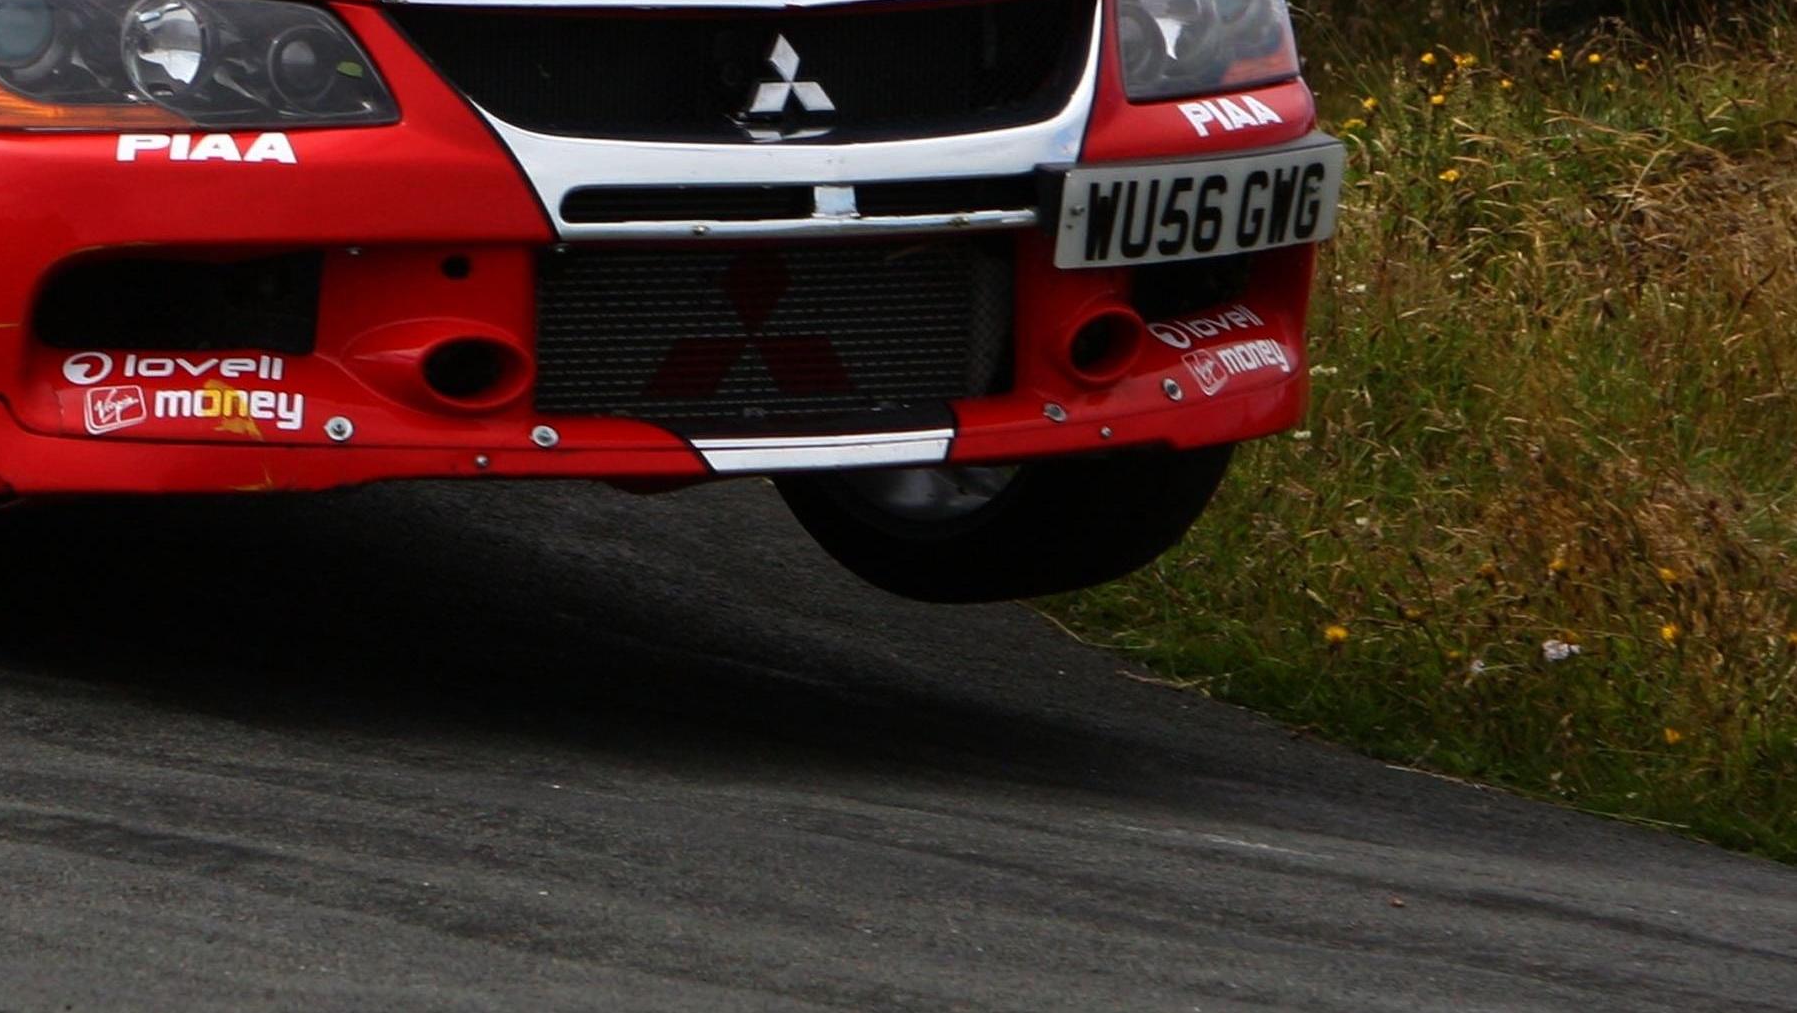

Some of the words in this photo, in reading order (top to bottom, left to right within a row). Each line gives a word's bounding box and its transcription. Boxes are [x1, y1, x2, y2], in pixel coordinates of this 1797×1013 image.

[1176, 93, 1283, 137] PIAA
[115, 133, 298, 164] PIAA
[1083, 172, 1228, 263] WU56
[1235, 161, 1326, 250] GWG
[1172, 303, 1266, 339] lovell
[124, 353, 284, 381] lovell
[1216, 338, 1291, 374] money
[154, 389, 304, 430] money
